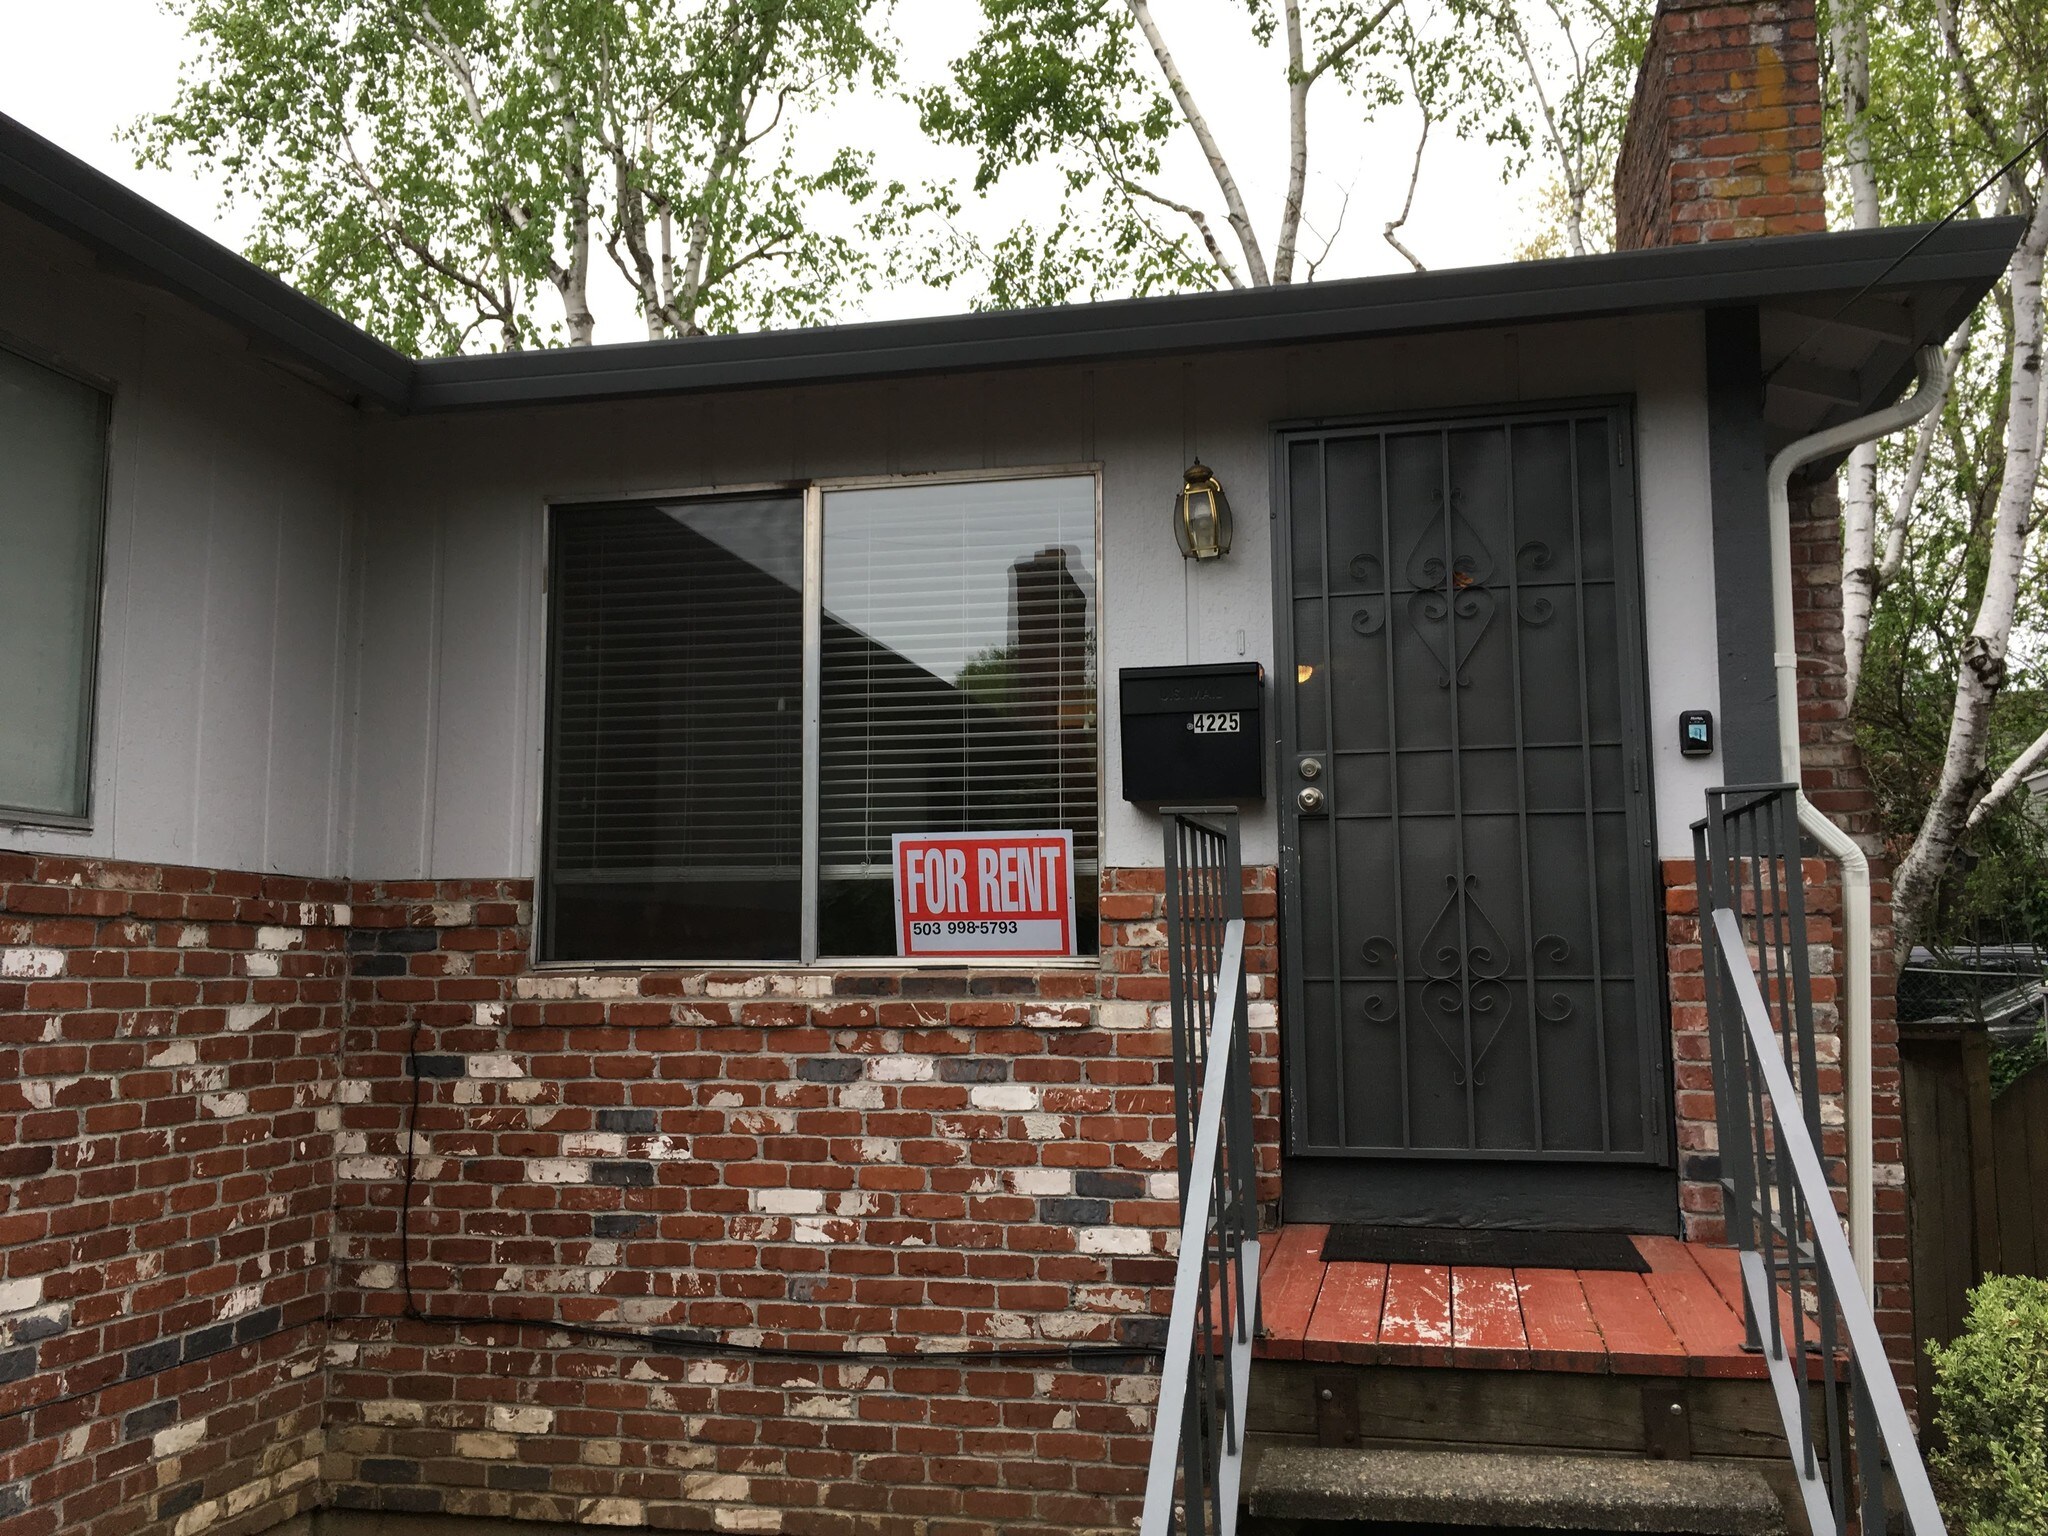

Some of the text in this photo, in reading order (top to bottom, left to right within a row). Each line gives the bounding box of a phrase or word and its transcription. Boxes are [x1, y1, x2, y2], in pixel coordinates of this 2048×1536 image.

[1195, 712, 1239, 732] 4225
[906, 846, 1061, 914] FOR RENT
[913, 921, 1018, 936] 503 998-5793
